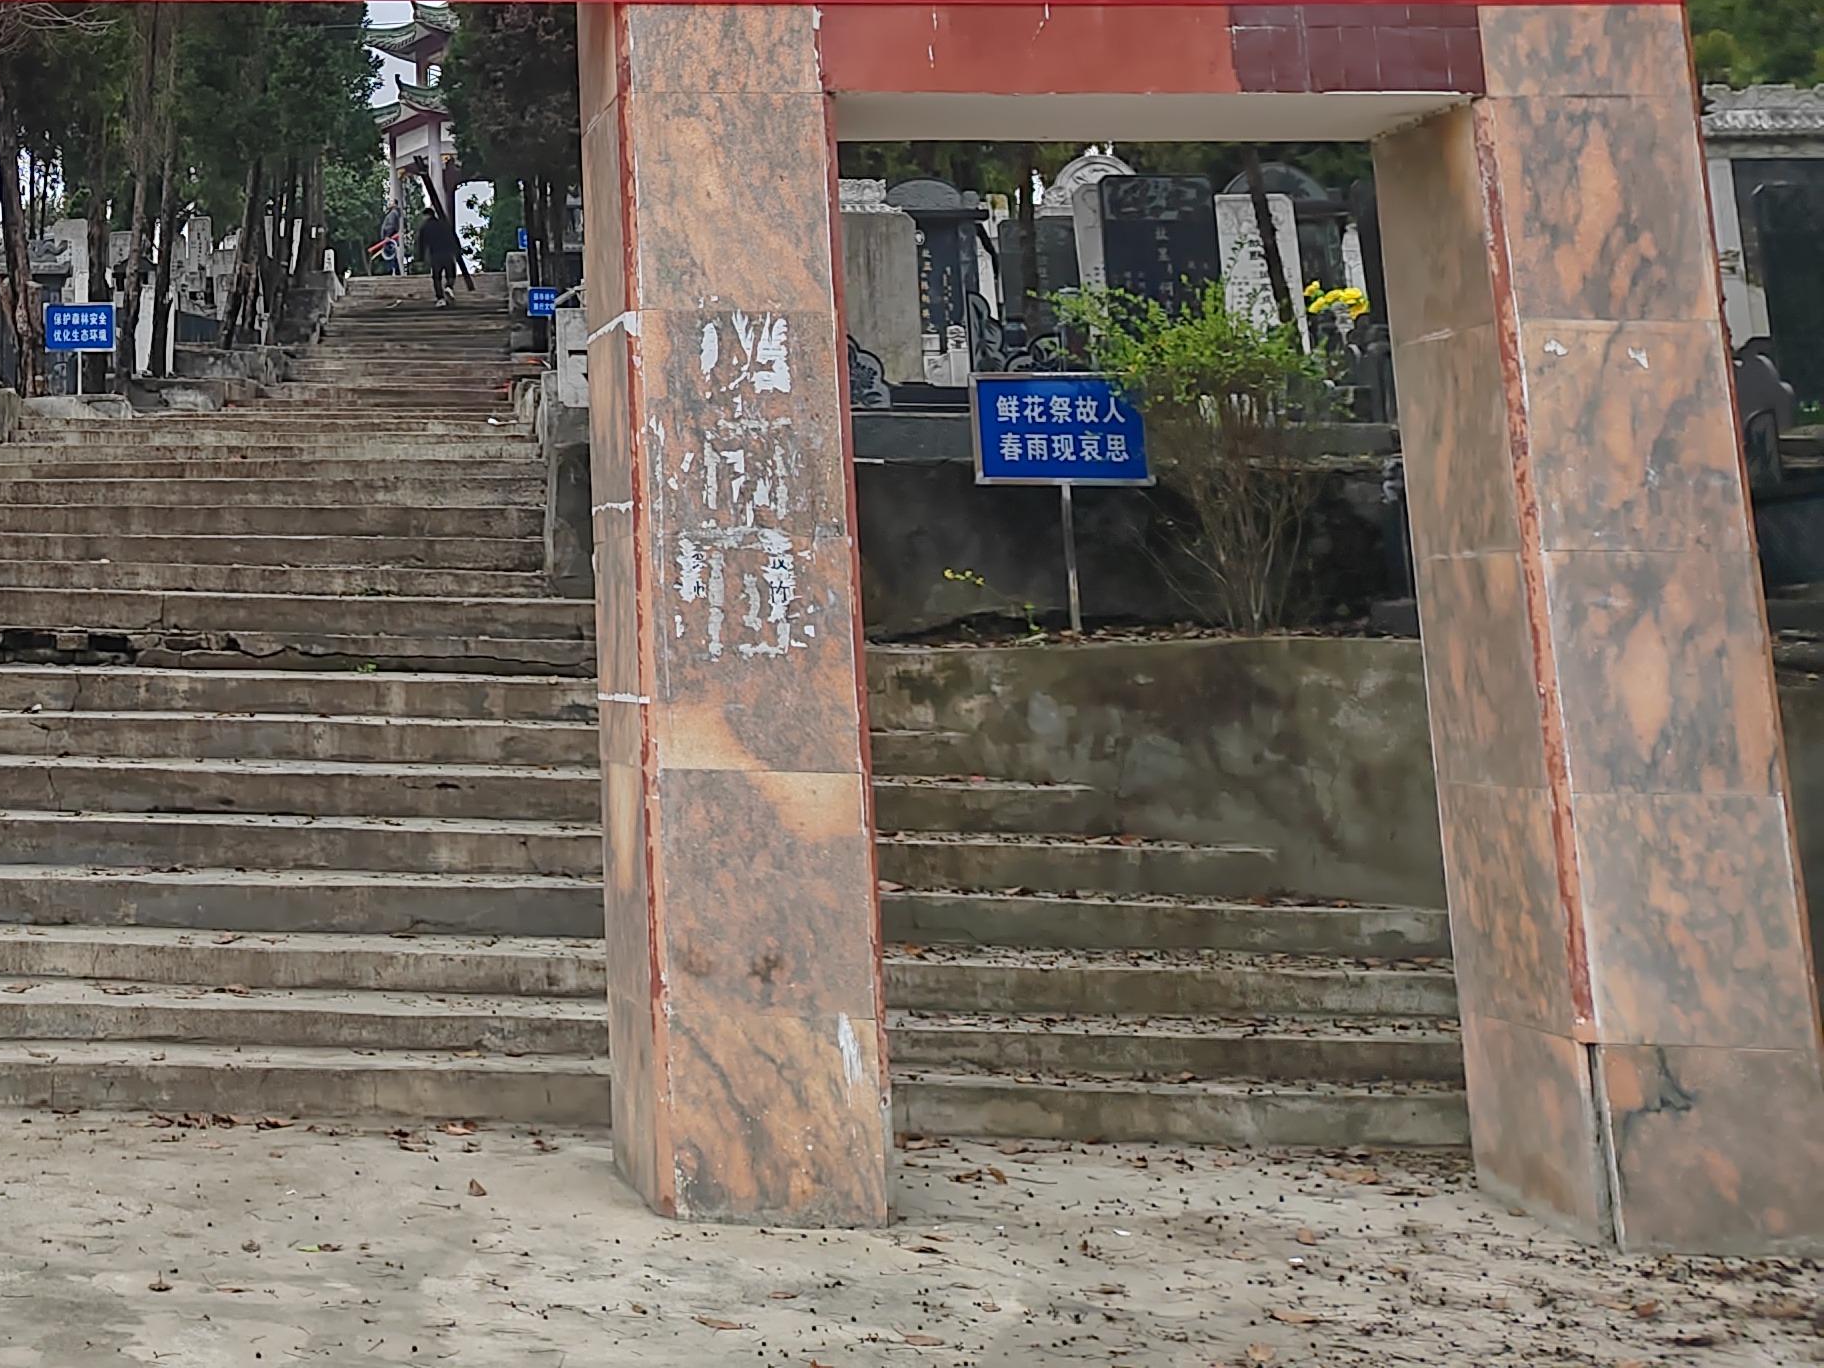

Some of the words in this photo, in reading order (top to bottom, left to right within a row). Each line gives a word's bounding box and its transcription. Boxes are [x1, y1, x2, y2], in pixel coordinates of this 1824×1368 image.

[53, 312, 108, 326] 保护森林安全
[996, 395, 1126, 424] 鲜花祭故人
[999, 432, 1130, 462] 春雨现哀思
